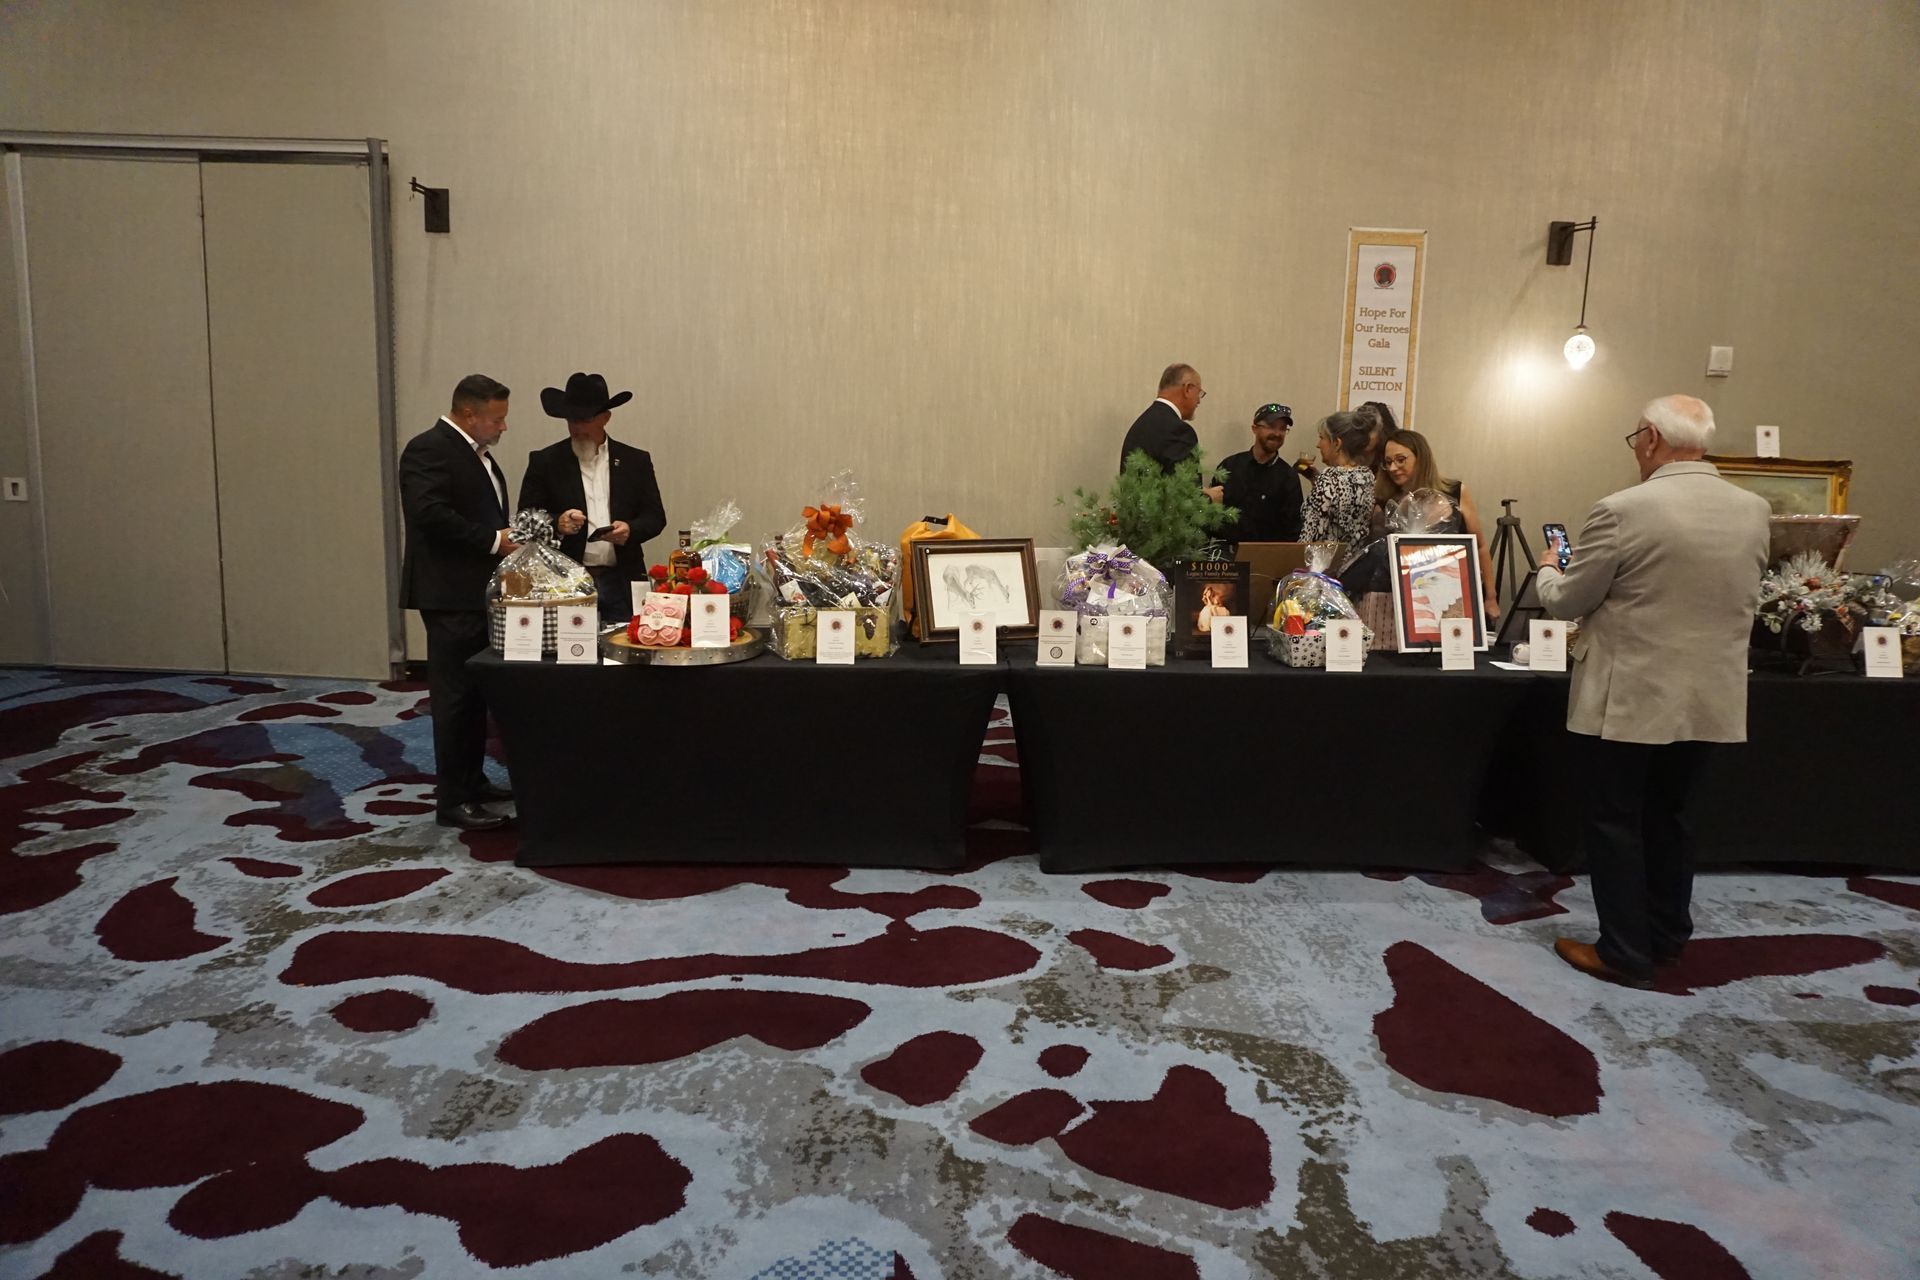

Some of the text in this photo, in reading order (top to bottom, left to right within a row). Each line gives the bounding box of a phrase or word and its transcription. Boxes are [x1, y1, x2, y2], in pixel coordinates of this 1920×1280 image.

[1359, 307, 1406, 320] Hope For
[1355, 323, 1409, 334] Our Heroes
[1367, 338, 1390, 348] Gala
[1358, 366, 1397, 376] SILENT
[1352, 380, 1403, 391] AUCTION
